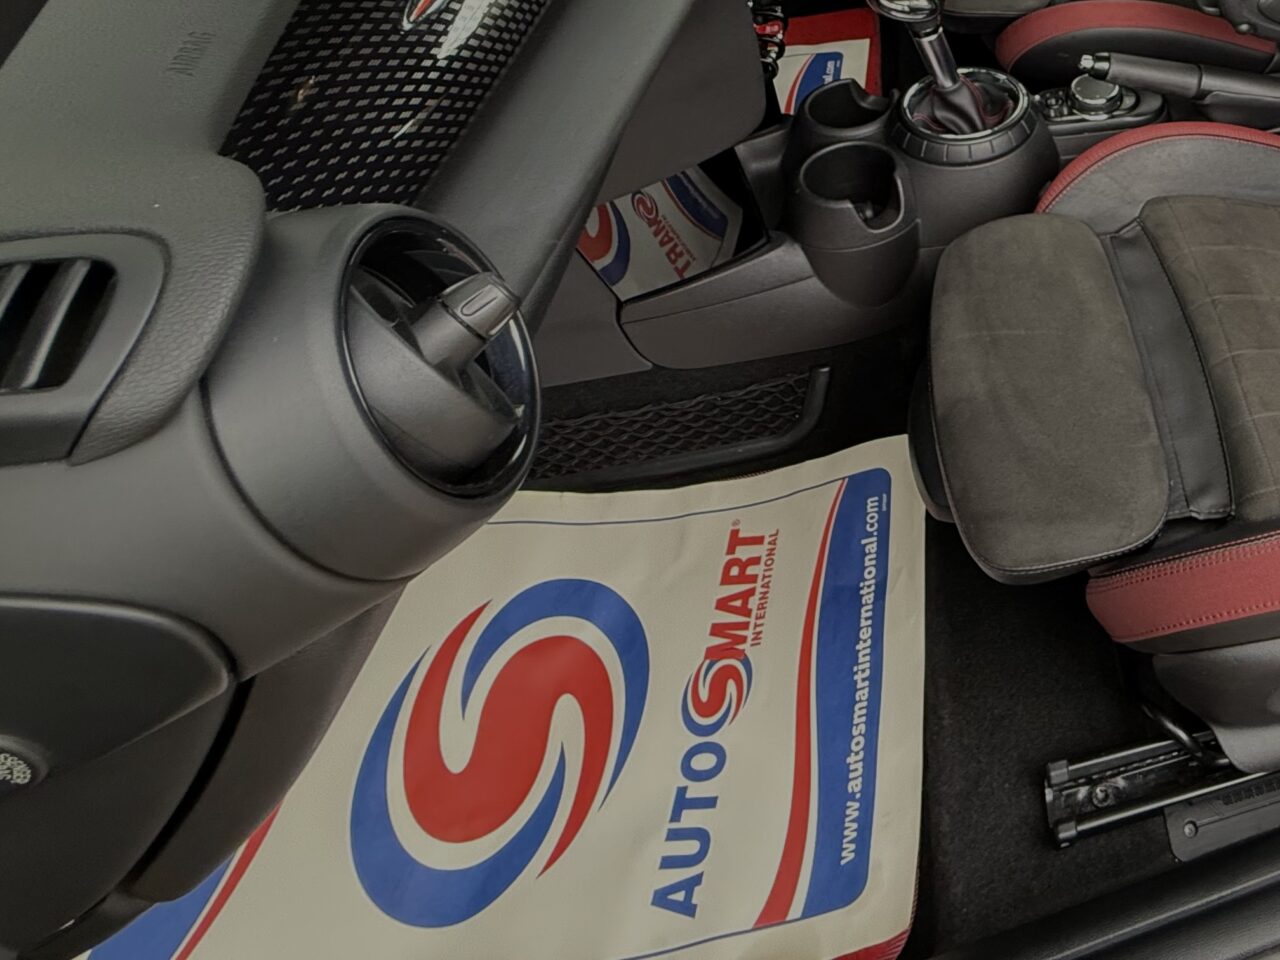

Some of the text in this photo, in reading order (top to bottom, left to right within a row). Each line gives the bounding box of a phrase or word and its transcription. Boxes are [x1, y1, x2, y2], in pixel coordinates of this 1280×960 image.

[650, 528, 766, 920] AUTOSMART
[750, 528, 780, 647] INTERNATIONAL
[840, 494, 880, 866] www.autosmartinternational.com
